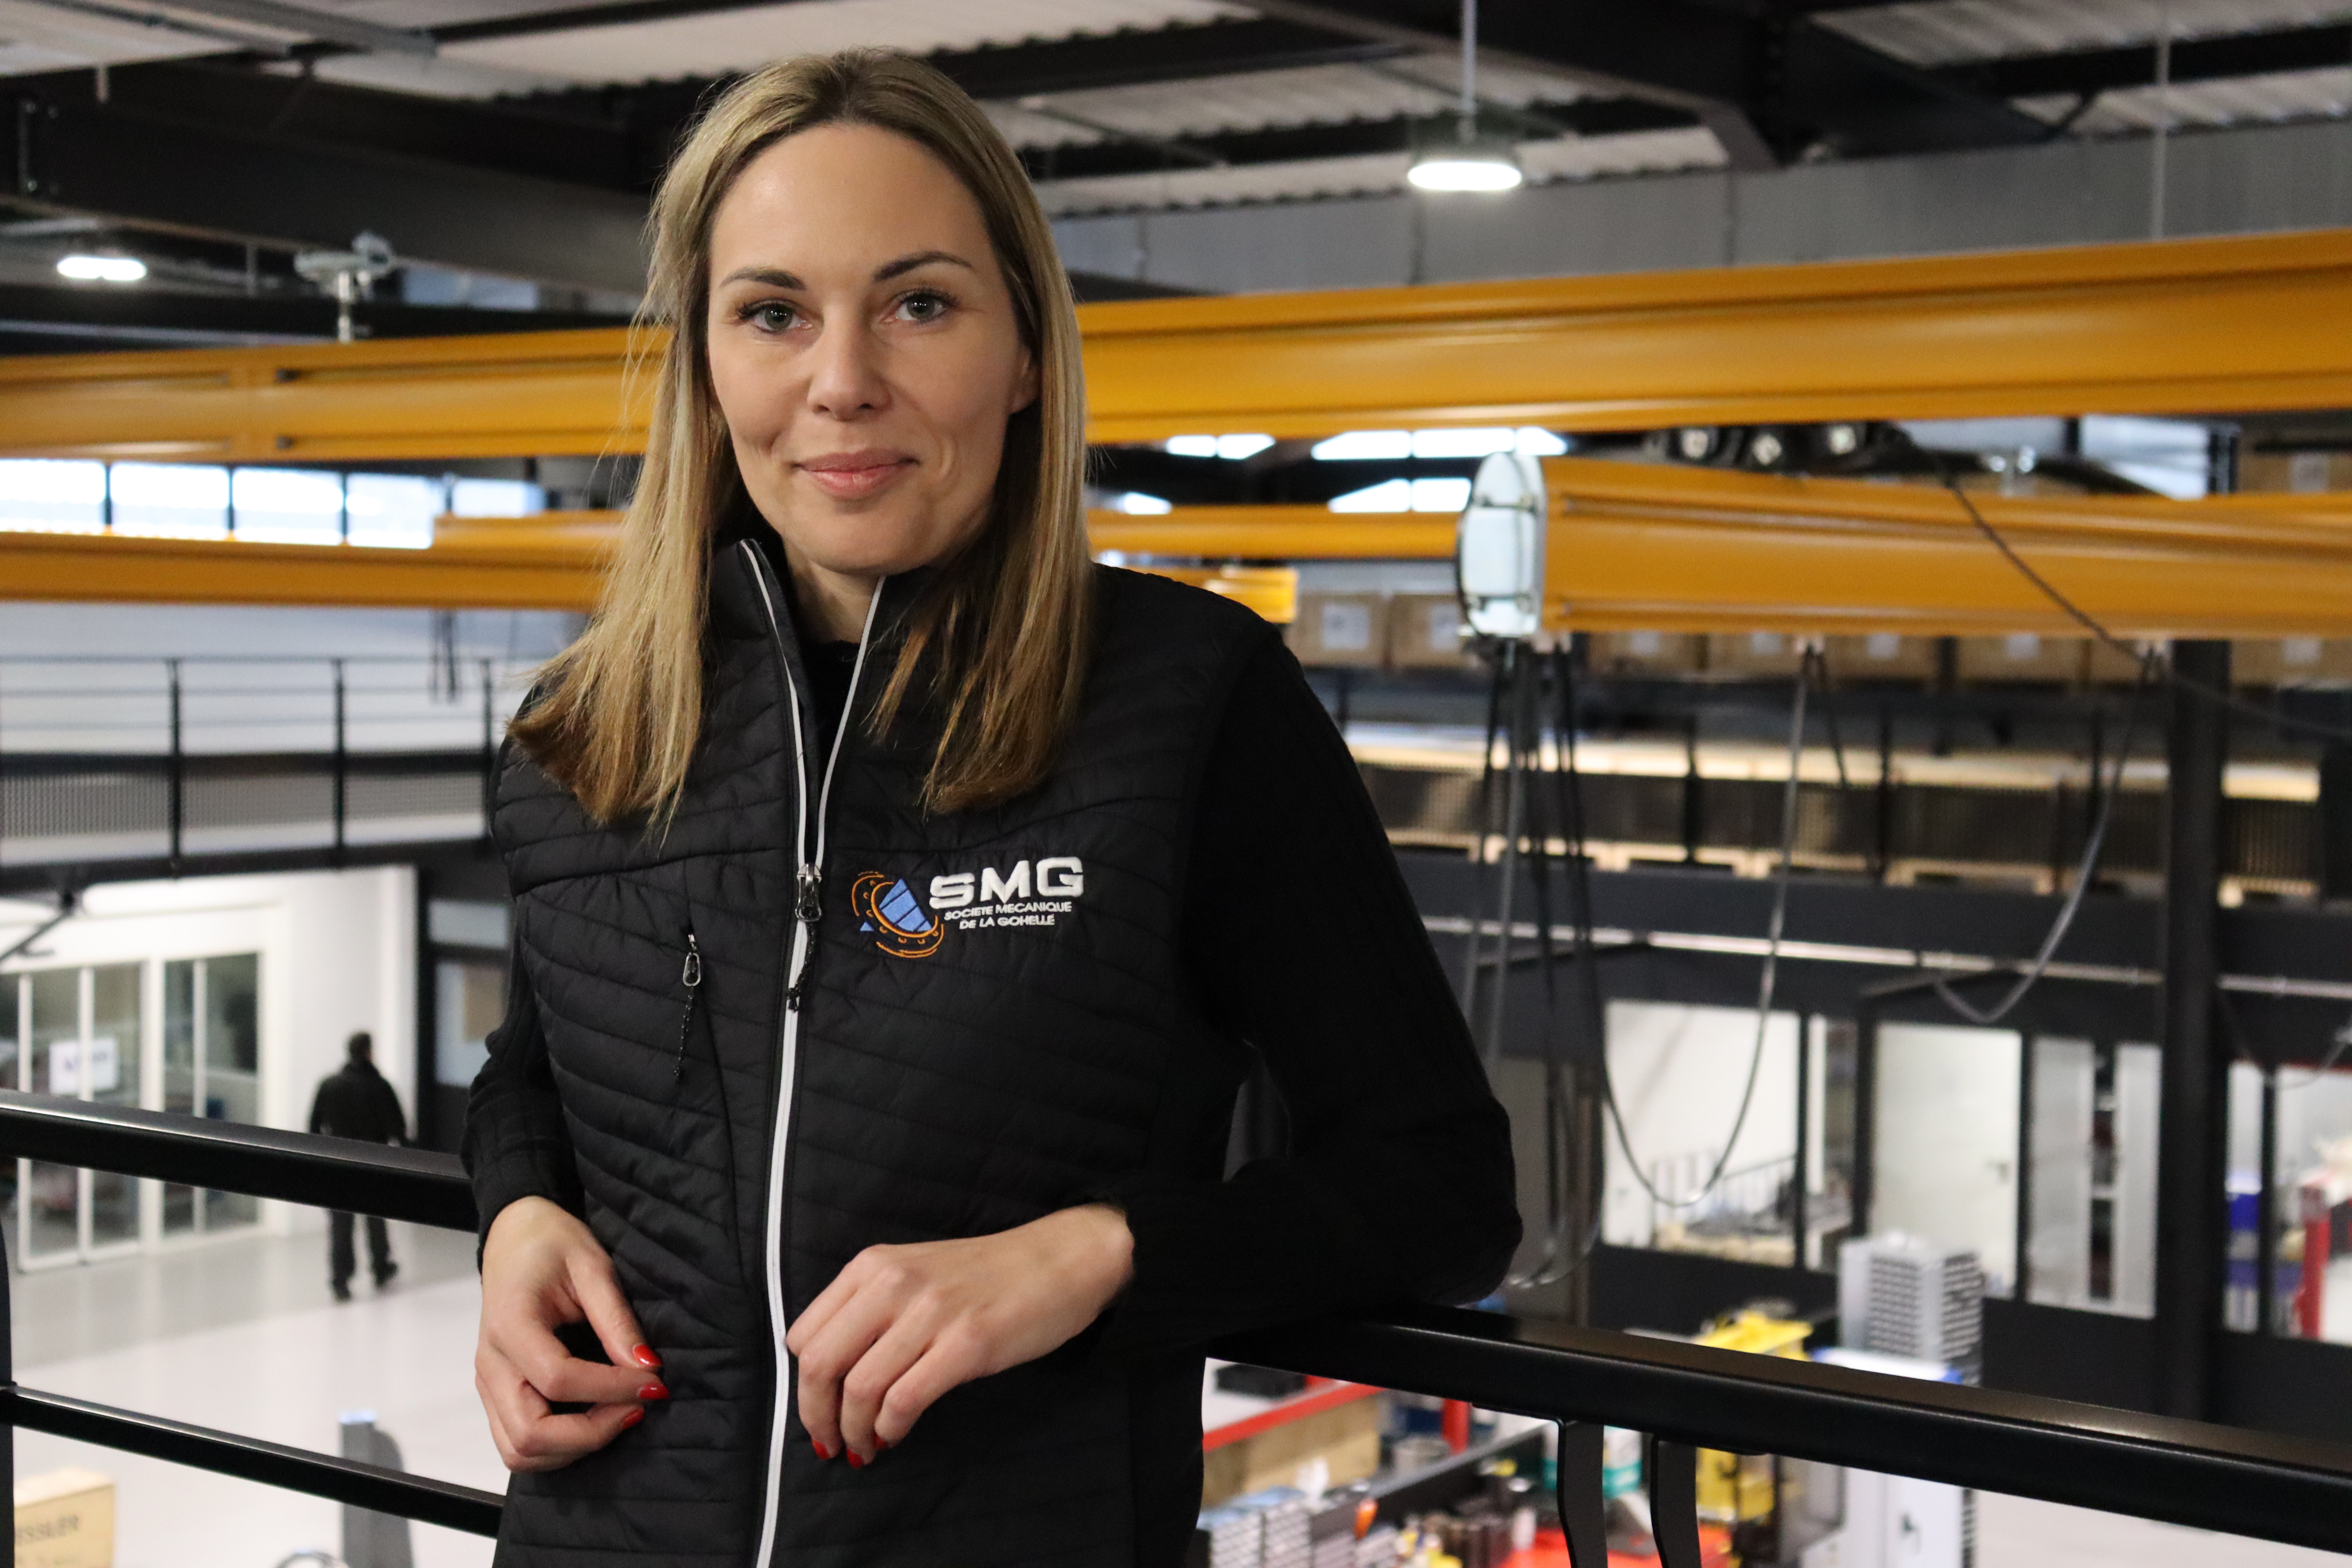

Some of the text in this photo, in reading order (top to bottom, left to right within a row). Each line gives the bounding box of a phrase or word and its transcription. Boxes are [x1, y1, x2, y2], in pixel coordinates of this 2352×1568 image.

[929, 857, 1083, 909] SMG
[944, 902, 1072, 920] SOCIETE MECANIQUE
[959, 914, 1055, 929] DE LA GOHELLE
